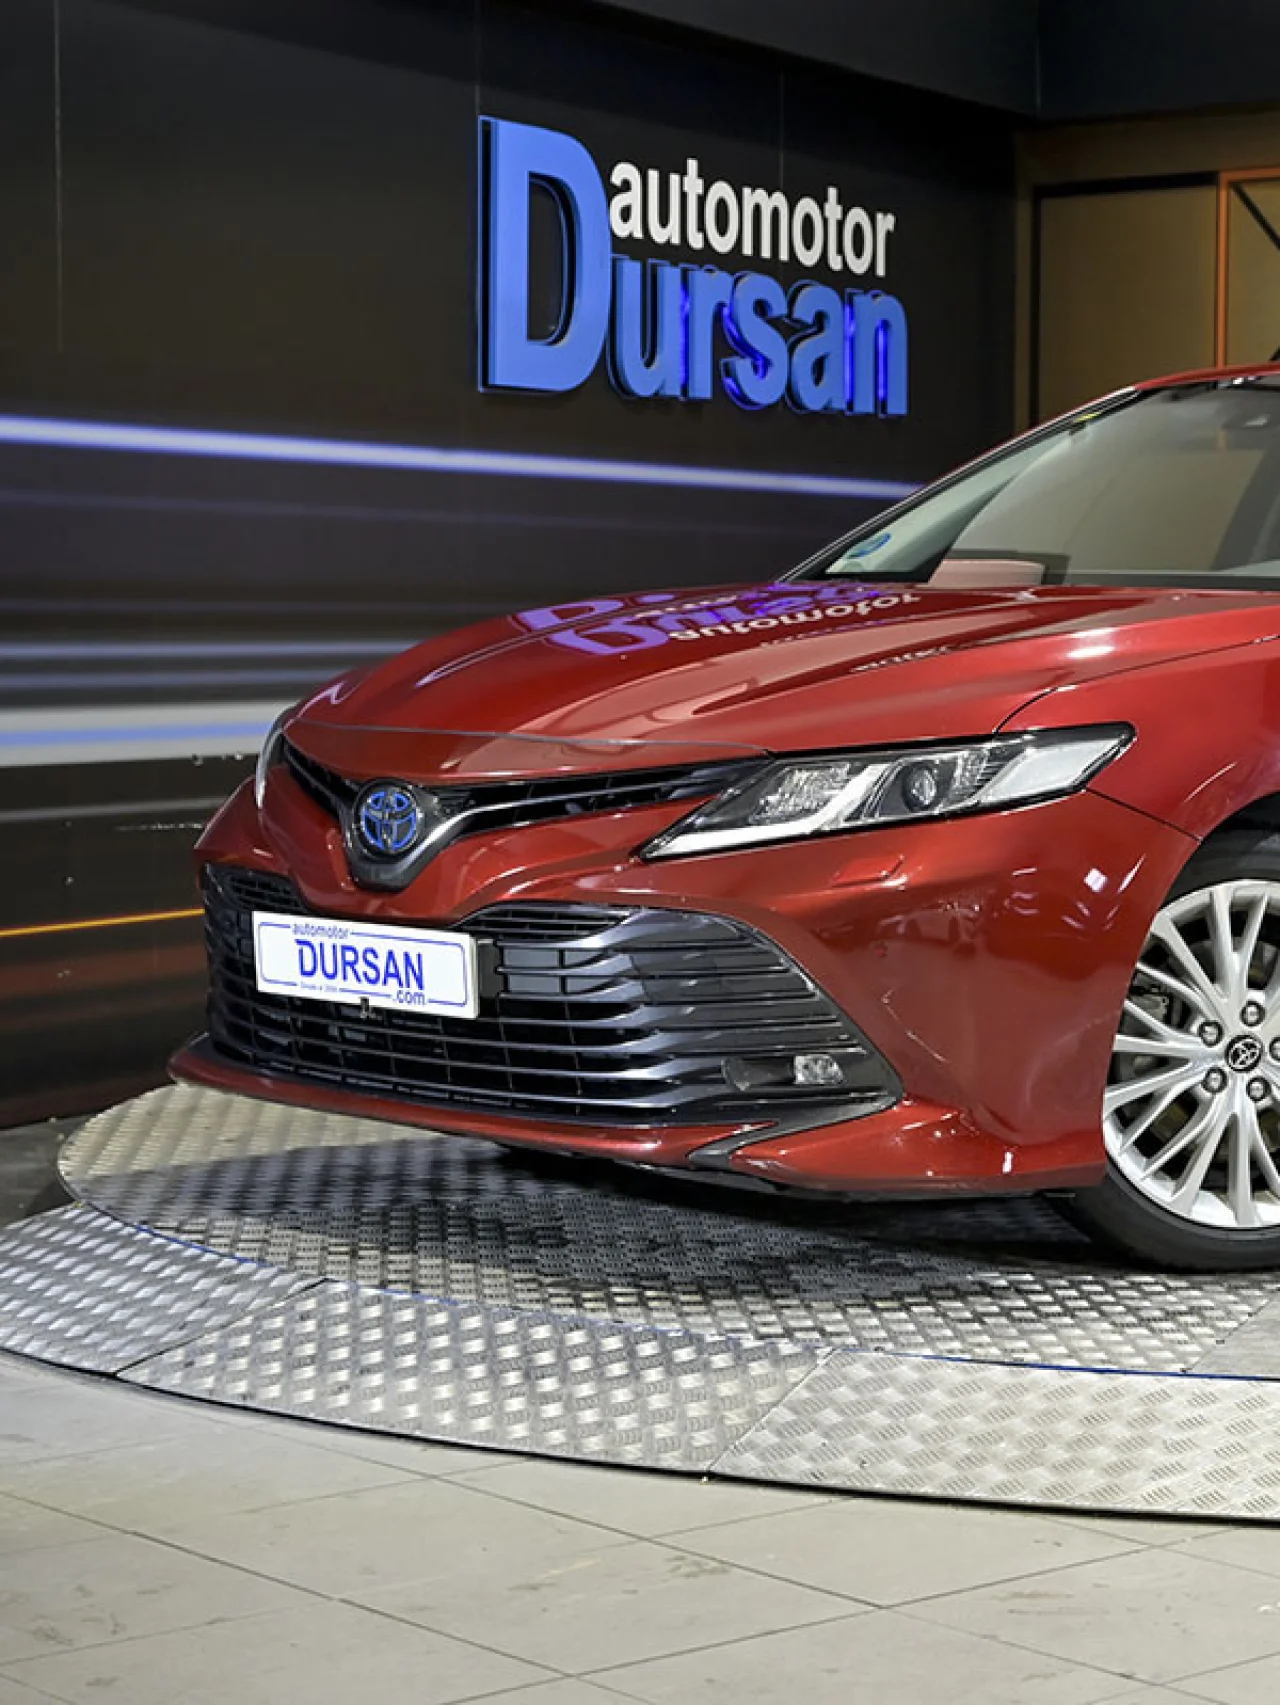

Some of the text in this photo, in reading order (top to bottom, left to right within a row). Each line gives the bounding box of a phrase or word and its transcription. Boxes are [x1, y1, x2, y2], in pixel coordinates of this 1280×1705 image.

[610, 158, 895, 277] automotor
[478, 114, 909, 418] Dursan
[292, 923, 350, 939] automotor
[294, 938, 425, 991] DURSAN
[393, 988, 426, 1005] .com
